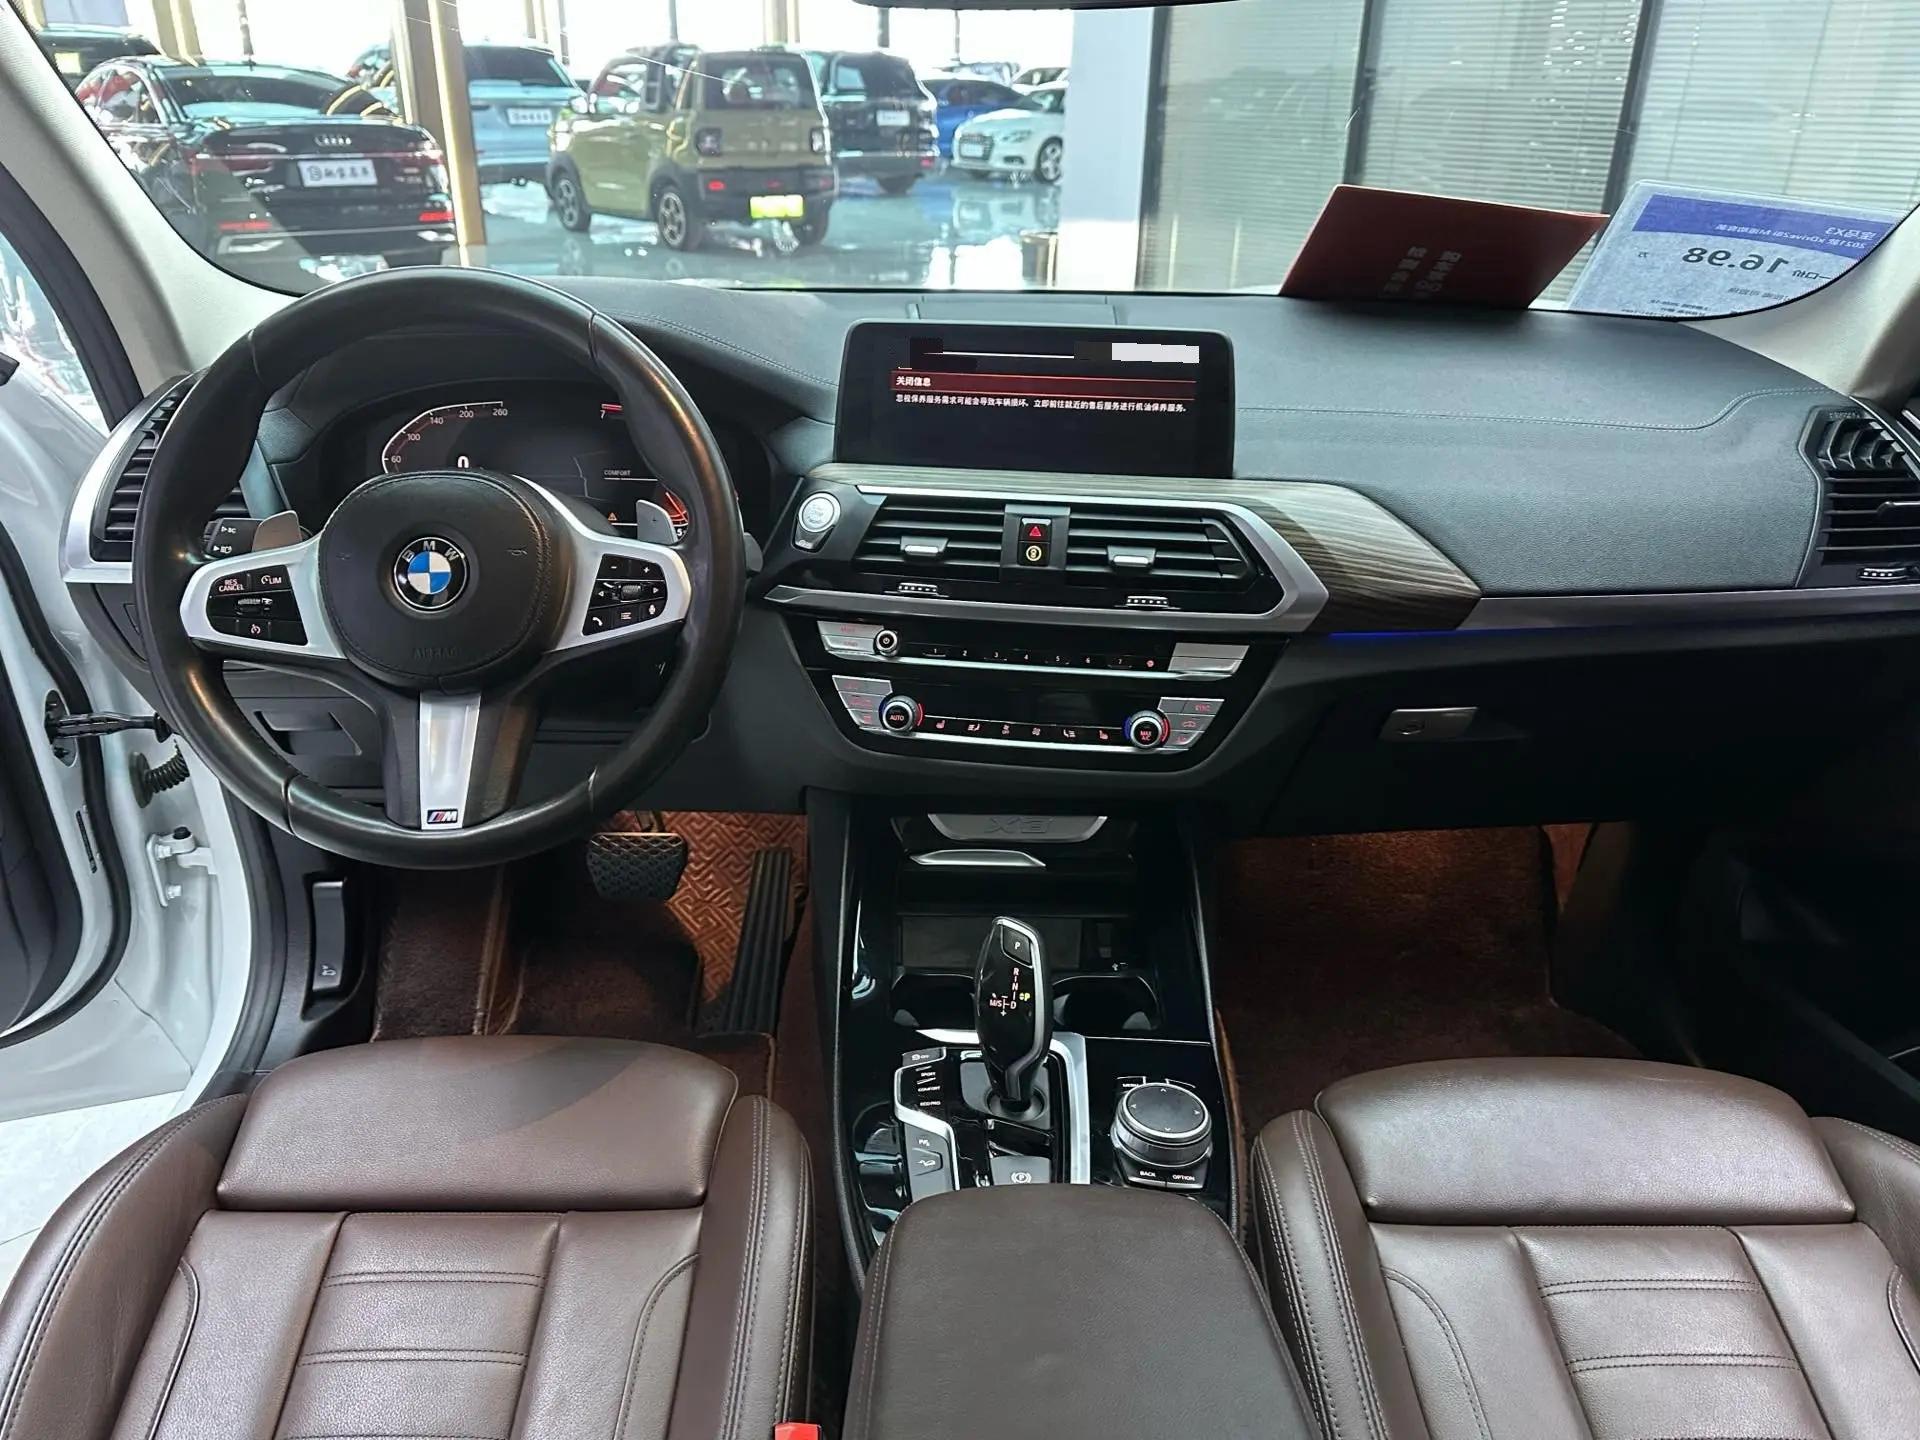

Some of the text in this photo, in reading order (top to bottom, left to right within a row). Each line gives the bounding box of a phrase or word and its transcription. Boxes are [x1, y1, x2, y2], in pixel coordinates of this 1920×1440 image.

[896, 376, 931, 387] 关闭信息
[459, 410, 474, 419] 200
[492, 408, 508, 417] 260
[430, 416, 444, 426] 140
[407, 433, 421, 442] 100
[391, 455, 402, 464] 60
[604, 469, 631, 477] COMFORT
[401, 540, 459, 562] BMW
[224, 578, 238, 586] RES
[218, 583, 245, 592] CANCEL
[1024, 653, 1029, 661] 4
[890, 714, 905, 722] AUTO
[1014, 941, 1021, 950] P
[1013, 967, 1020, 976] R
[1011, 982, 1019, 991] N
[1024, 992, 1031, 1002] P
[1010, 1001, 1017, 1010] D
[1140, 1170, 1157, 1178] BACK
[1172, 1174, 1196, 1182] OPTION
